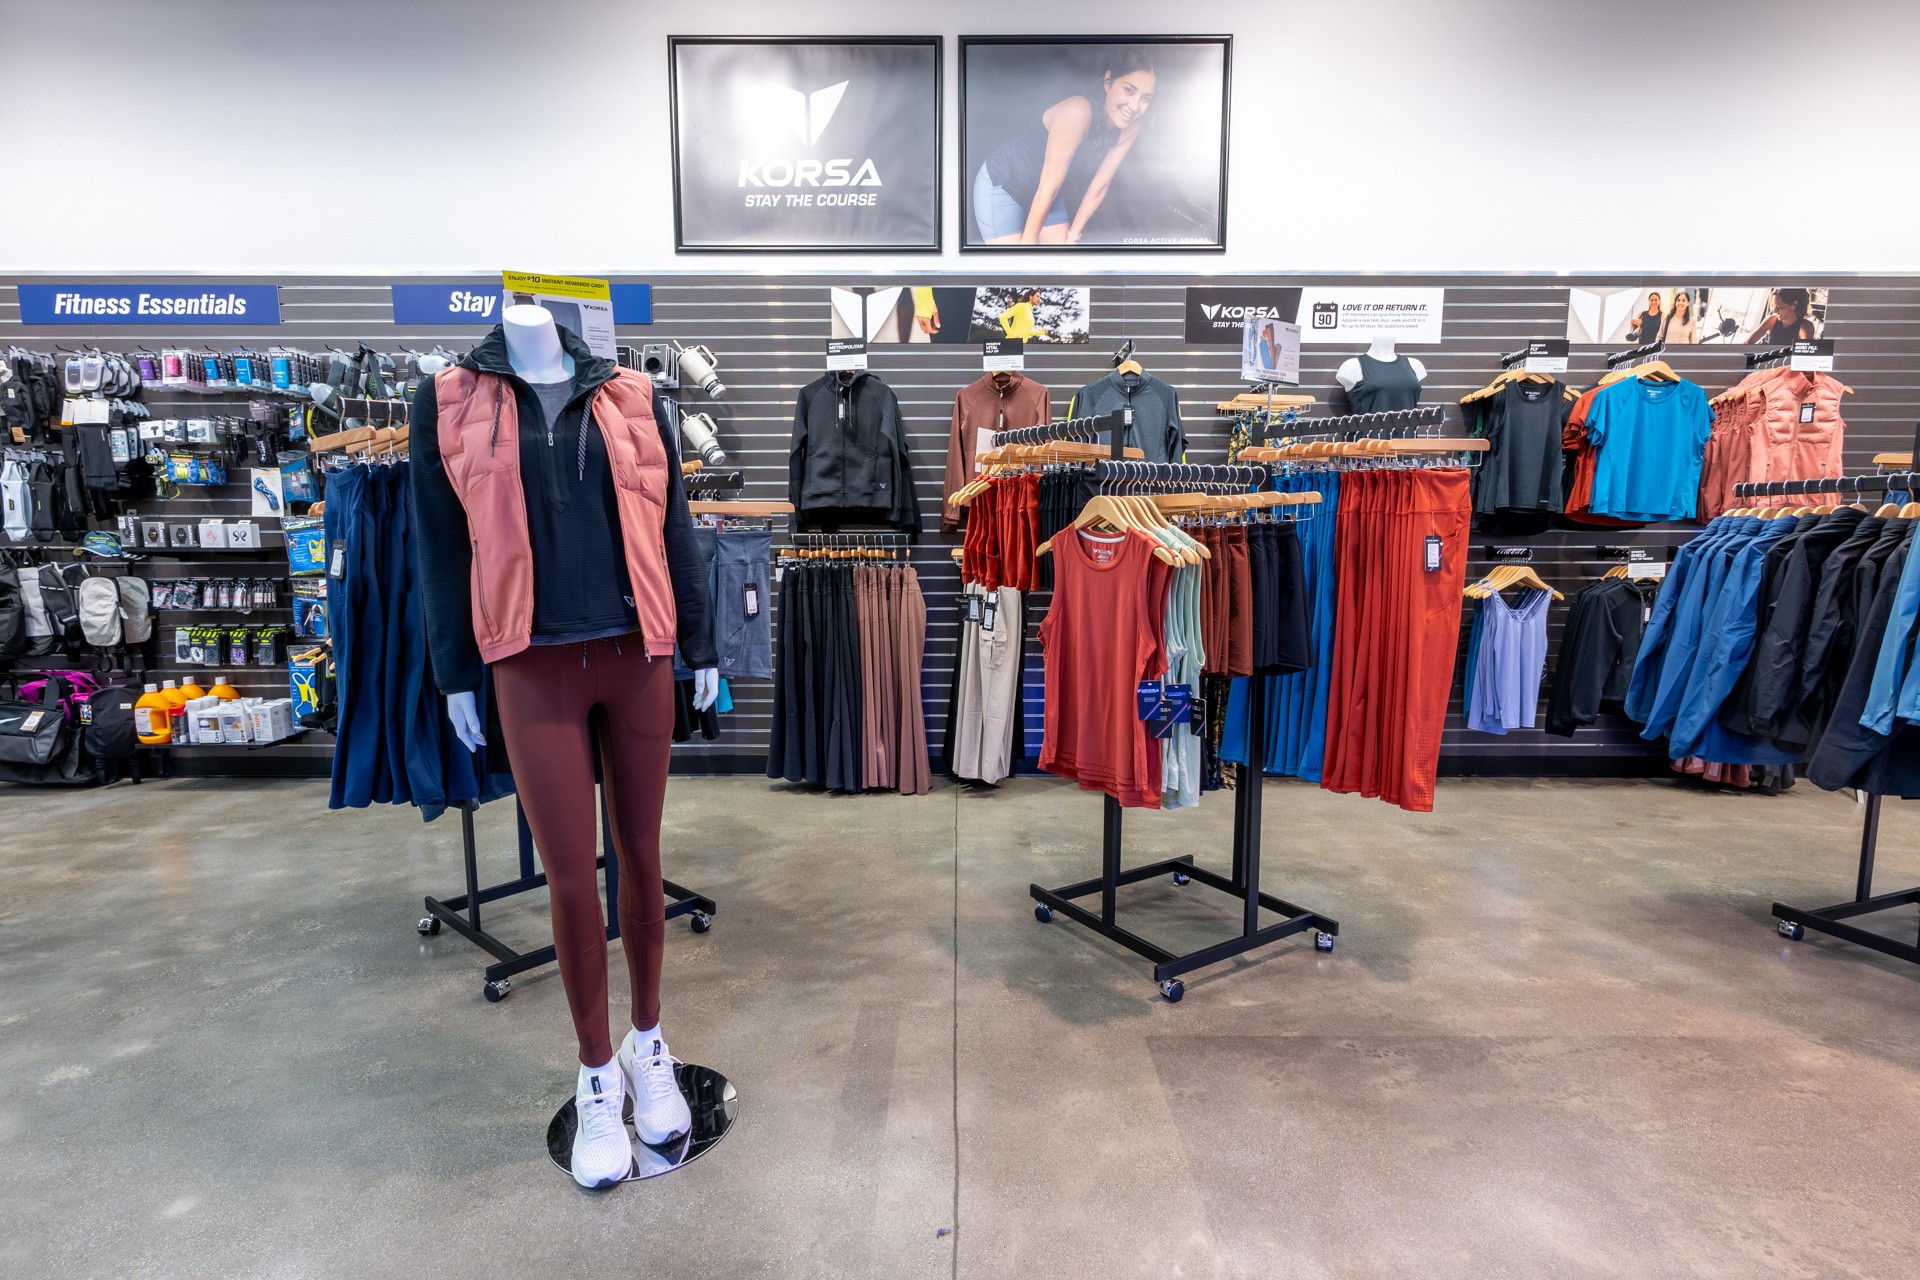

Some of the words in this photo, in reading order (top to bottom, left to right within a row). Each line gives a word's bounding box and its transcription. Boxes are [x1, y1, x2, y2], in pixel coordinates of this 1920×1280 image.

[738, 158, 882, 188] KORSA
[745, 194, 782, 207] STAY
[786, 194, 813, 206] THE
[816, 194, 877, 206] COURSE
[54, 293, 131, 315] Fitness
[138, 293, 246, 315] Essentials
[449, 291, 496, 317] Stay
[1221, 307, 1279, 318] KORSA
[1318, 314, 1332, 325] 90
[127, 517, 136, 543] GARMIN
